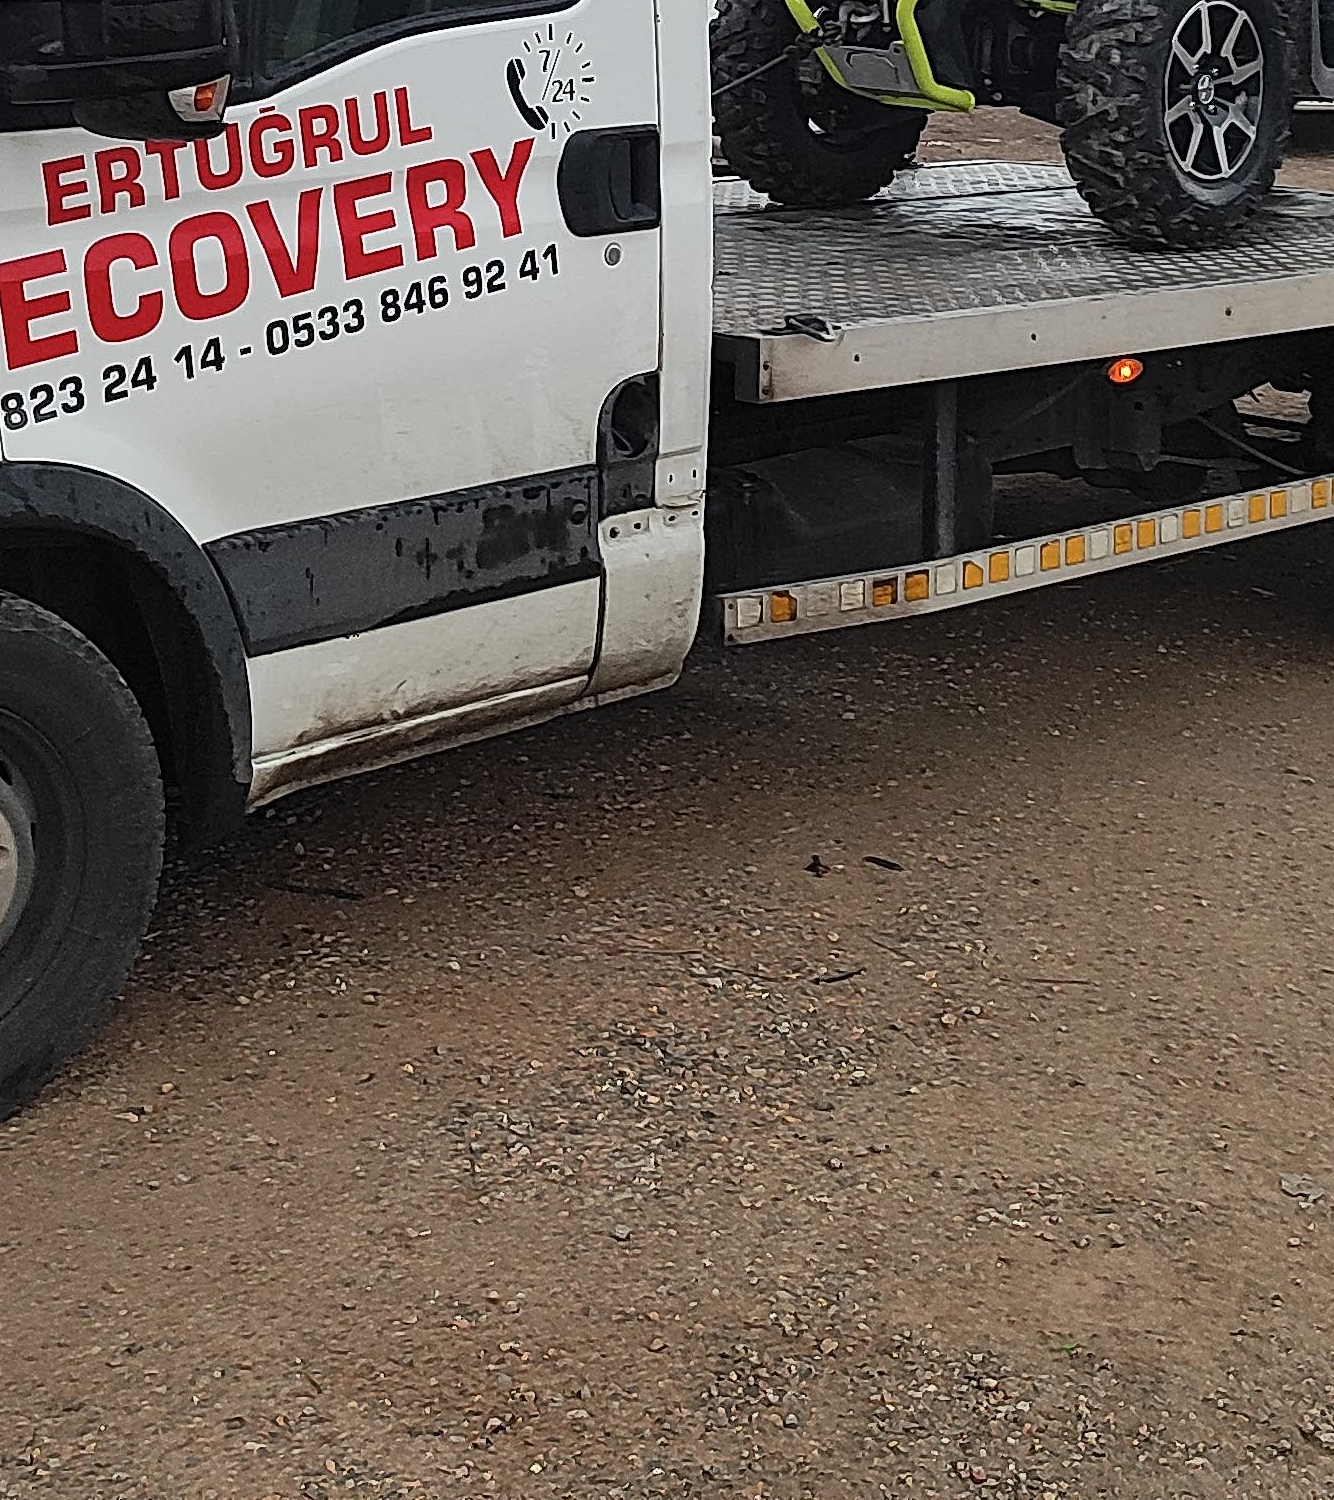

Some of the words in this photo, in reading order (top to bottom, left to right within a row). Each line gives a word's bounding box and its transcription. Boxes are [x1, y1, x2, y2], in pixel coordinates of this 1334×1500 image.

[0, 375, 86, 432] 823
[101, 355, 158, 404] 24
[173, 336, 227, 381] 14
[265, 298, 366, 357] 0533
[379, 275, 450, 323] 846
[462, 259, 506, 300] 92
[519, 243, 559, 282] 41
